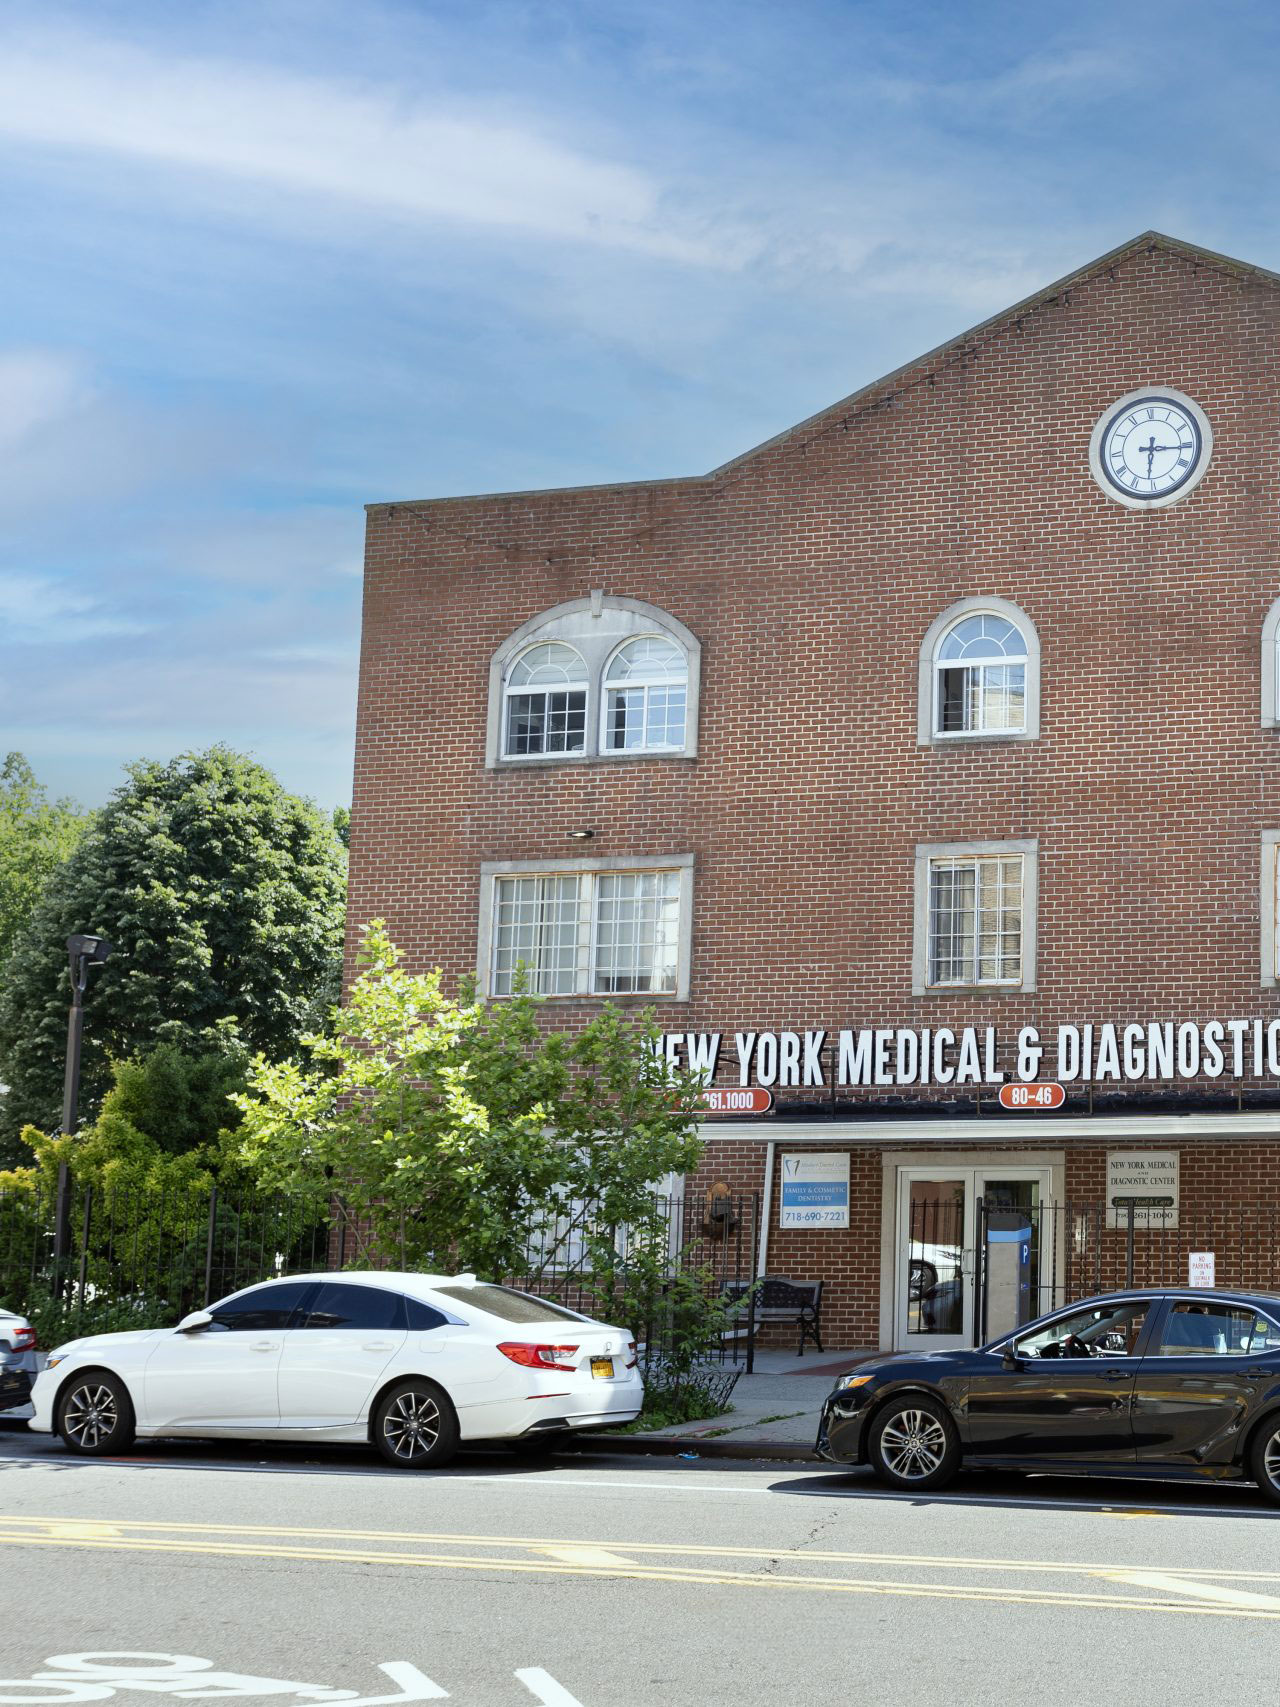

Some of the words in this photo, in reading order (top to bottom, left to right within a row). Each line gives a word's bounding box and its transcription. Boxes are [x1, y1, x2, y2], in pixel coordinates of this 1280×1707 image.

[735, 1031, 826, 1087] YORK
[840, 1027, 1004, 1085] MEDICAL
[1017, 1026, 1043, 1082] &
[1012, 1087, 1052, 1105] 80-46
[1111, 1161, 1125, 1169] NEW
[1128, 1161, 1145, 1169] YORK
[1147, 1161, 1176, 1169] MEDICAL
[1150, 1177, 1176, 1185] CENTER
[785, 1211, 845, 1221] 718-690-7221
[1023, 1244, 1029, 1264] P
